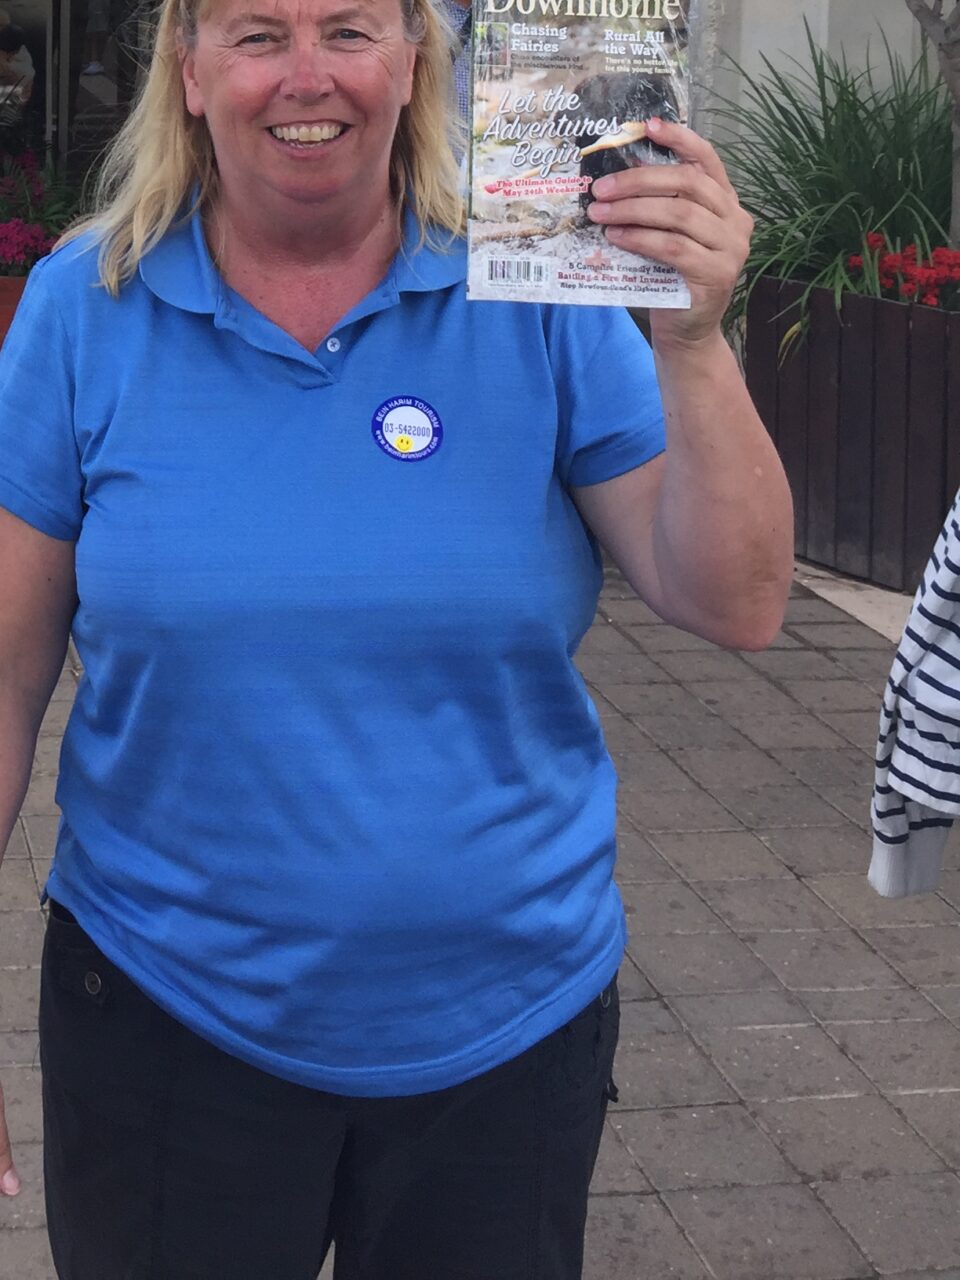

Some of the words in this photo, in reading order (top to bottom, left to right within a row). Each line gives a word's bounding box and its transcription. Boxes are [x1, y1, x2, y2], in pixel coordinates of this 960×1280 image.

[511, 23, 567, 40] Chasing
[604, 29, 640, 42] Rural
[645, 31, 665, 43] All
[511, 38, 560, 53] Fairies
[604, 43, 626, 55] the
[629, 43, 660, 59] Way
[499, 89, 537, 114] Let
[543, 85, 582, 112] the
[483, 114, 623, 141] Adventures
[511, 140, 583, 178] Begin
[497, 180, 513, 188] The
[515, 178, 553, 187] Ultimate
[554, 176, 581, 185] Guide
[503, 189, 524, 197] May
[576, 262, 615, 273] Campfire
[617, 264, 651, 274] Friendly
[558, 272, 592, 282] Battling
[602, 273, 620, 282] Fire
[621, 274, 638, 283] Ant
[640, 276, 679, 284] Invasion
[414, 399, 440, 428] TOURISM
[384, 422, 431, 438] 03-5422000
